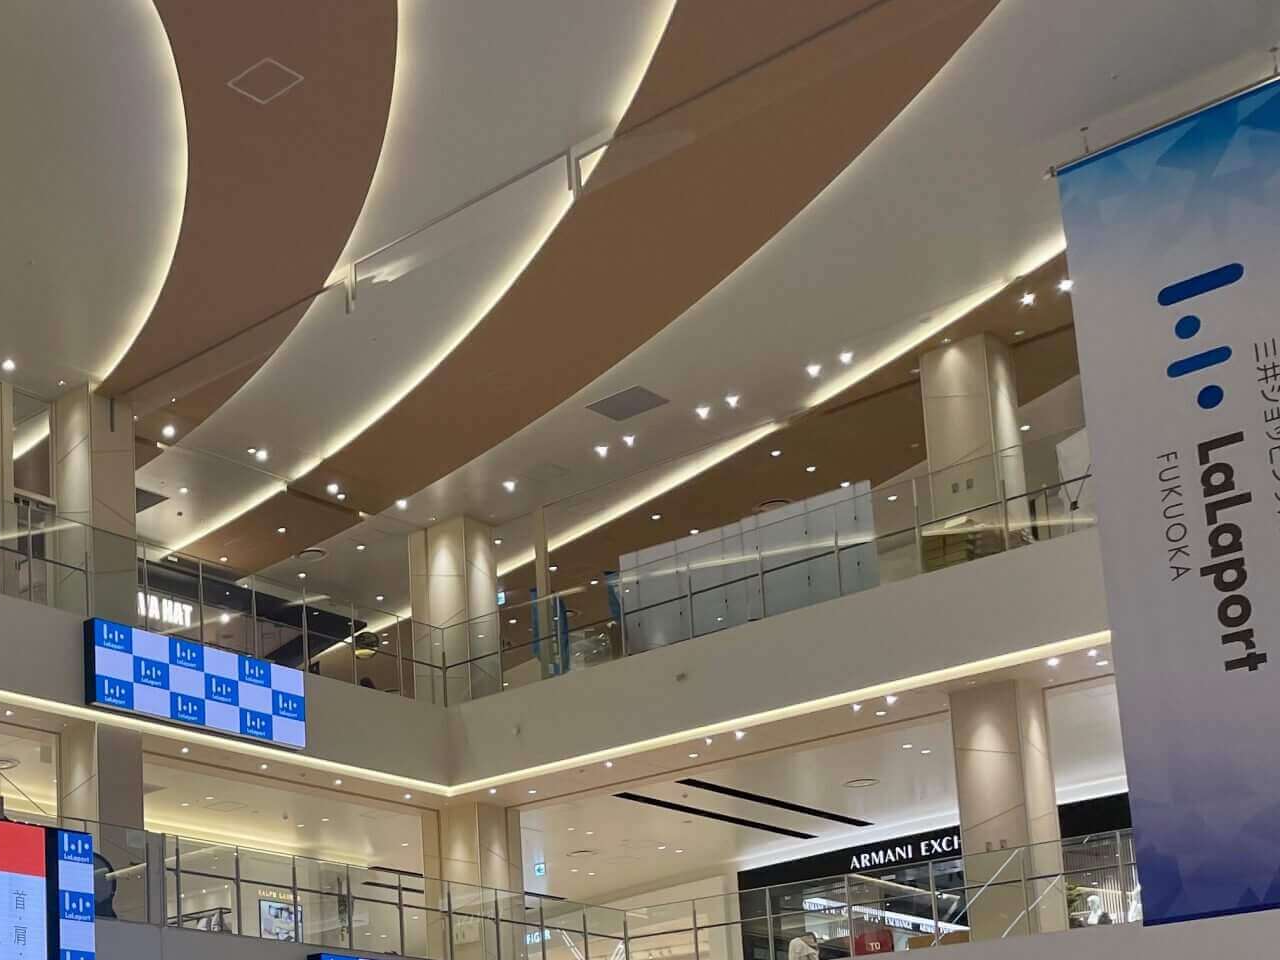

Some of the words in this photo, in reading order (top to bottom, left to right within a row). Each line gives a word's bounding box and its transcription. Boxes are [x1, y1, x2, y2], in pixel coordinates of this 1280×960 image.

[1156, 451, 1192, 582] FUKUOKA
[1197, 431, 1268, 672] LaLaport
[849, 844, 913, 870] ARMANI
